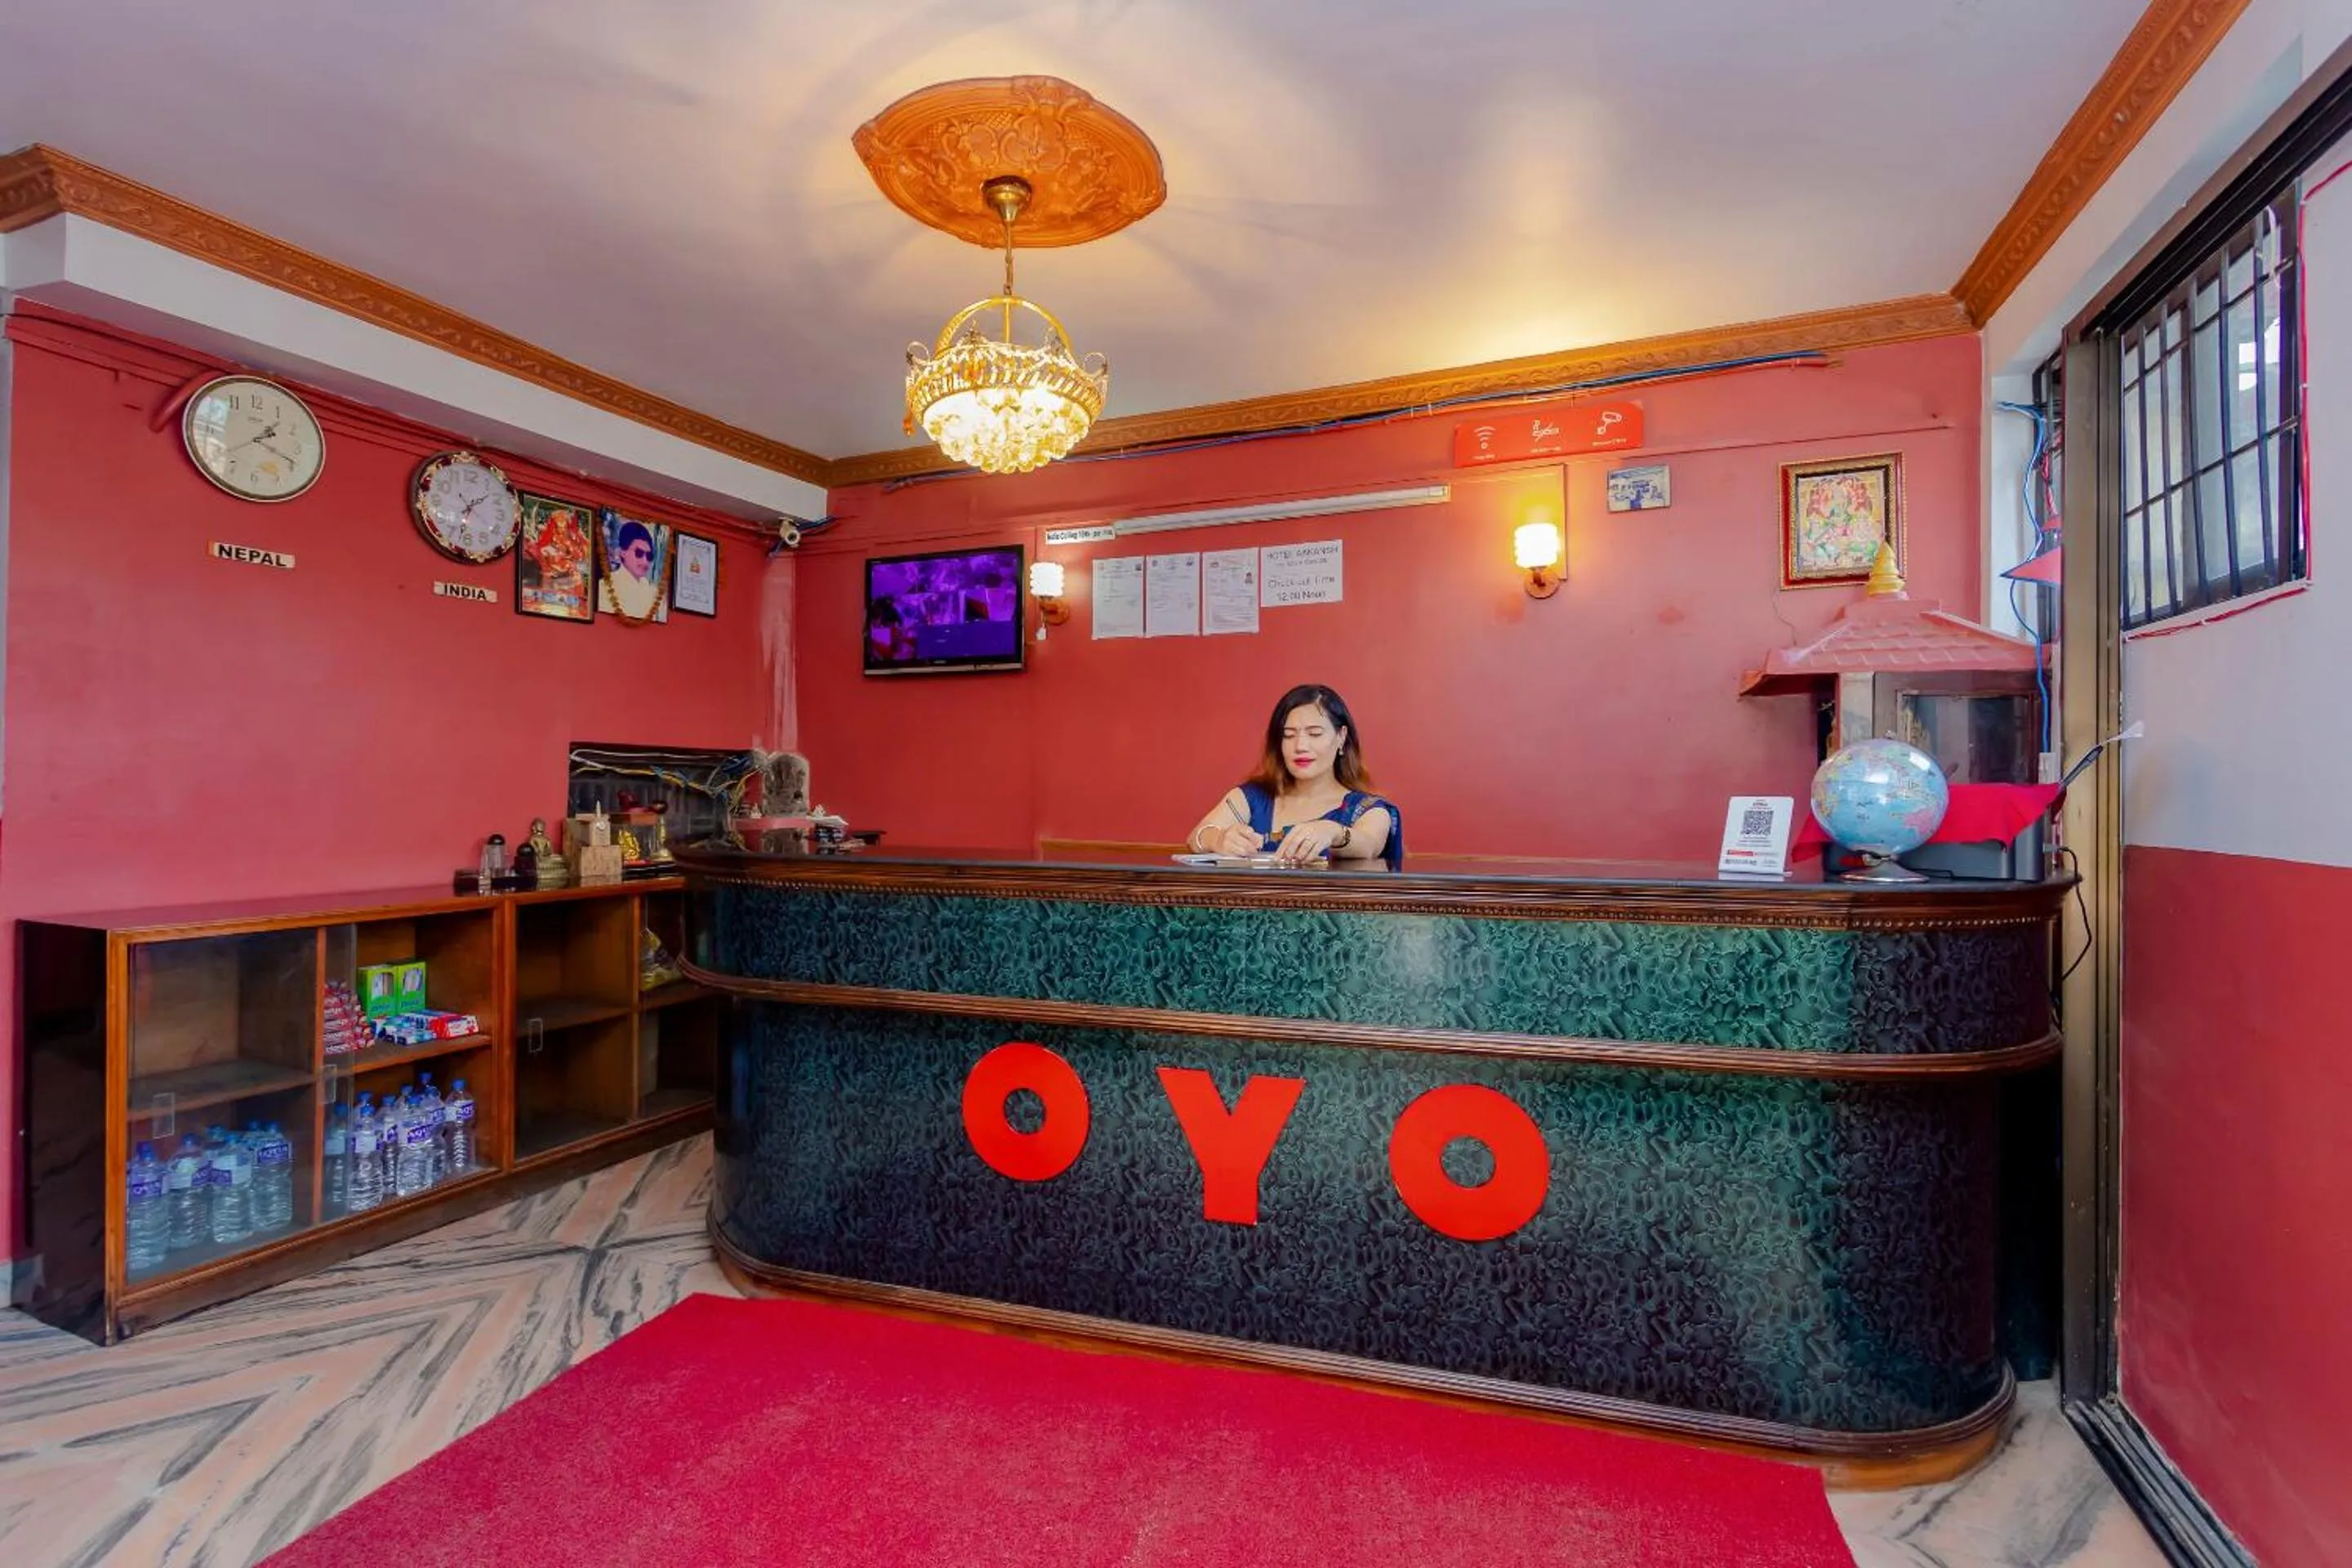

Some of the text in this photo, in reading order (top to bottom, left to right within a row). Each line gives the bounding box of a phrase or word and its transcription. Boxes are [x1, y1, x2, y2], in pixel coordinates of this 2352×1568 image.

[229, 394, 239, 410] 11
[218, 544, 287, 567] NEPAL
[444, 584, 486, 600] INDIA
[962, 1041, 1551, 1241] OYO
